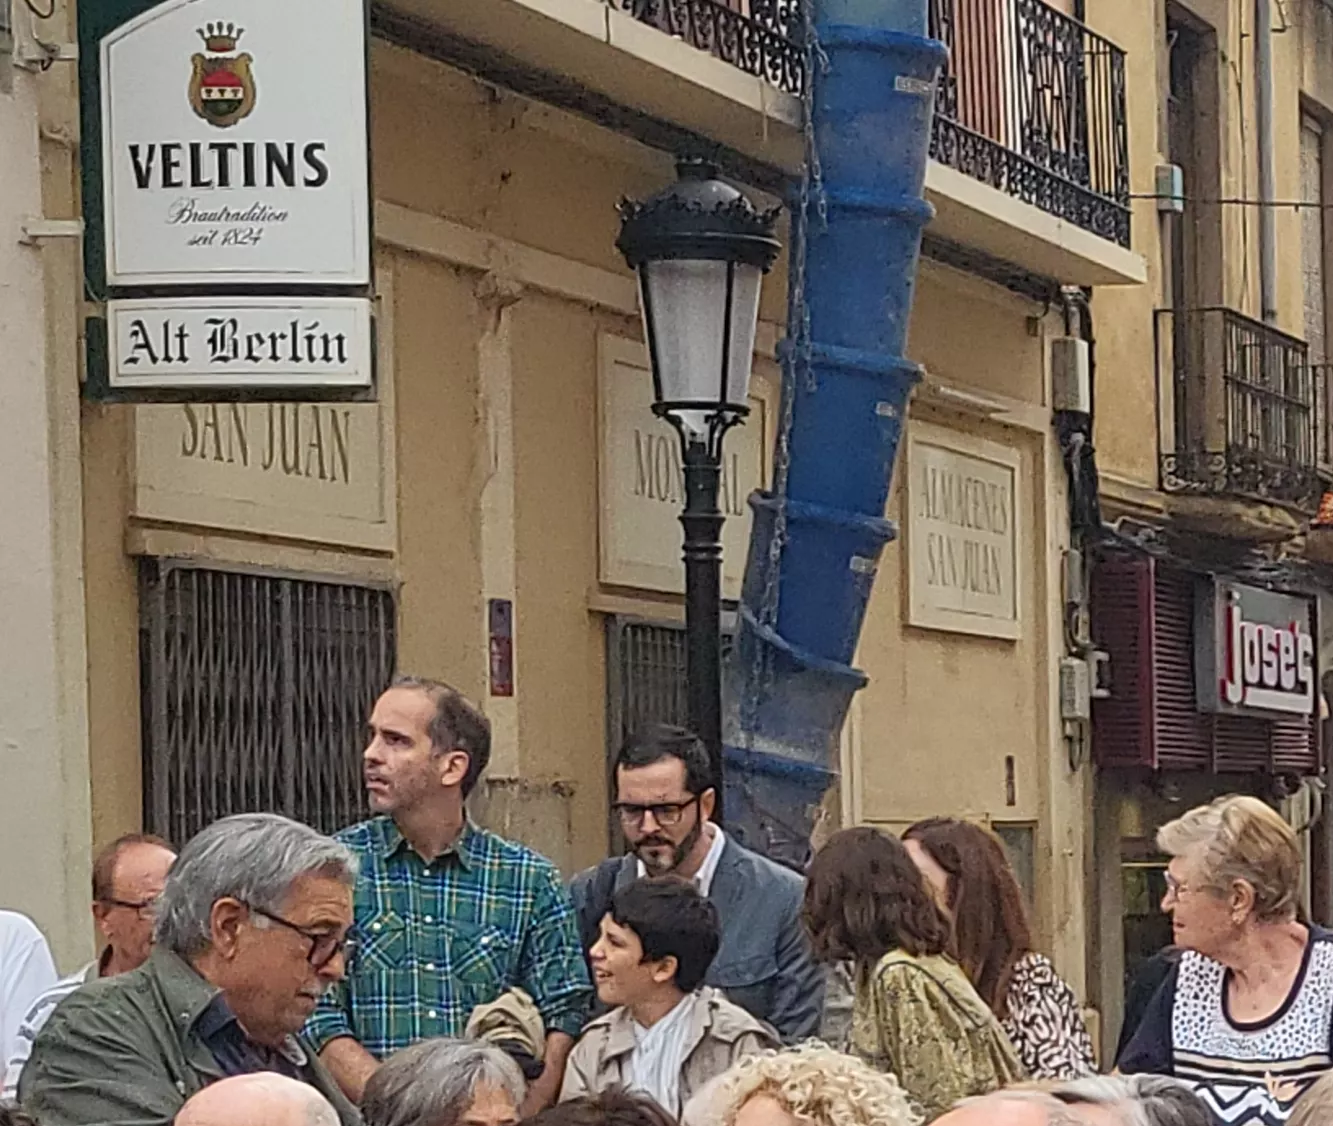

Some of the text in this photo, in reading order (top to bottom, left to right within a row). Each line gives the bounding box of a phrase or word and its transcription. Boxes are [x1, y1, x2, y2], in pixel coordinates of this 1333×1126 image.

[128, 141, 330, 189] VELTINS
[164, 198, 289, 226] Brautradition
[187, 227, 263, 246] seit 1824
[123, 317, 190, 365] Alt
[181, 402, 350, 484] SAN JUAN
[926, 532, 1002, 596] SAN JUAN
